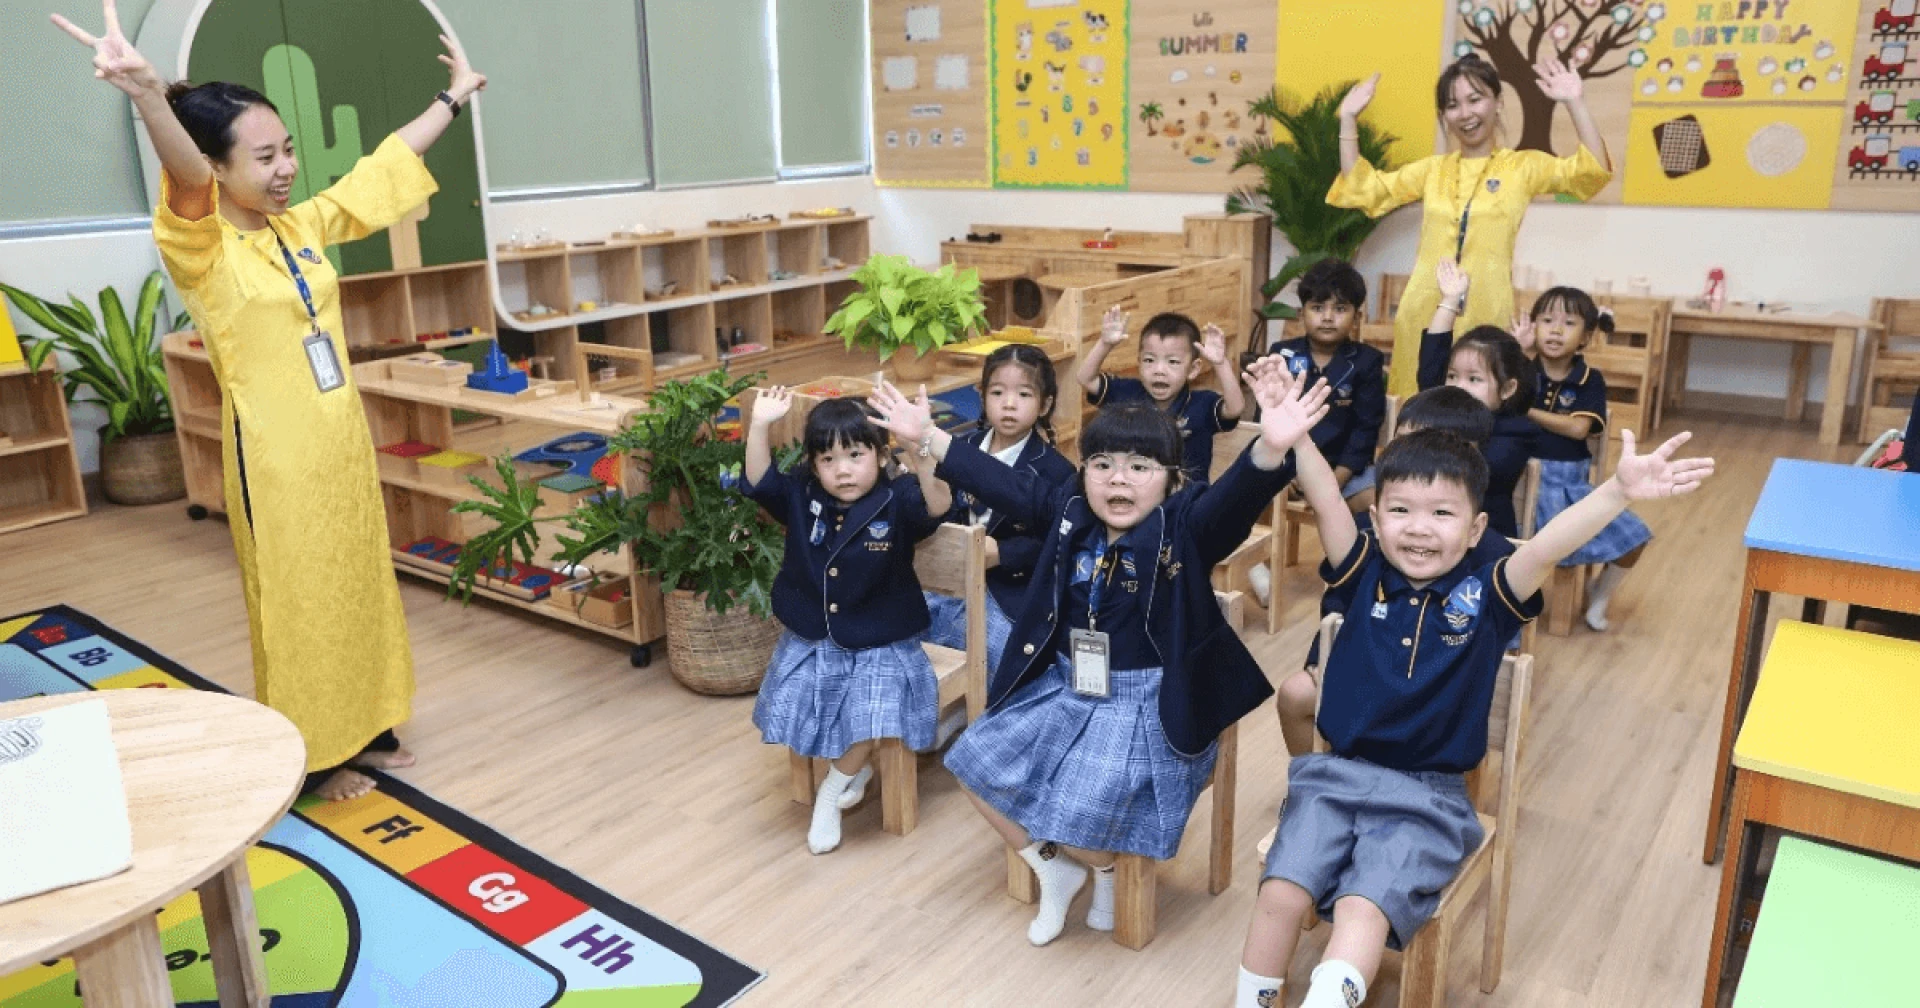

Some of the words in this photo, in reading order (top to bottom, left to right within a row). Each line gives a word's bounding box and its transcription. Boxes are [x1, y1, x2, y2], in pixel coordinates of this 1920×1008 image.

[1696, 0, 1789, 21] HAPPY
[1159, 32, 1248, 55] SUMMER
[1673, 24, 1812, 47] BIRTHDAY
[1076, 555, 1088, 576] K
[68, 647, 114, 667] Bb
[362, 815, 425, 844] Ff
[468, 872, 530, 913] Gg
[560, 924, 635, 975] Hh
